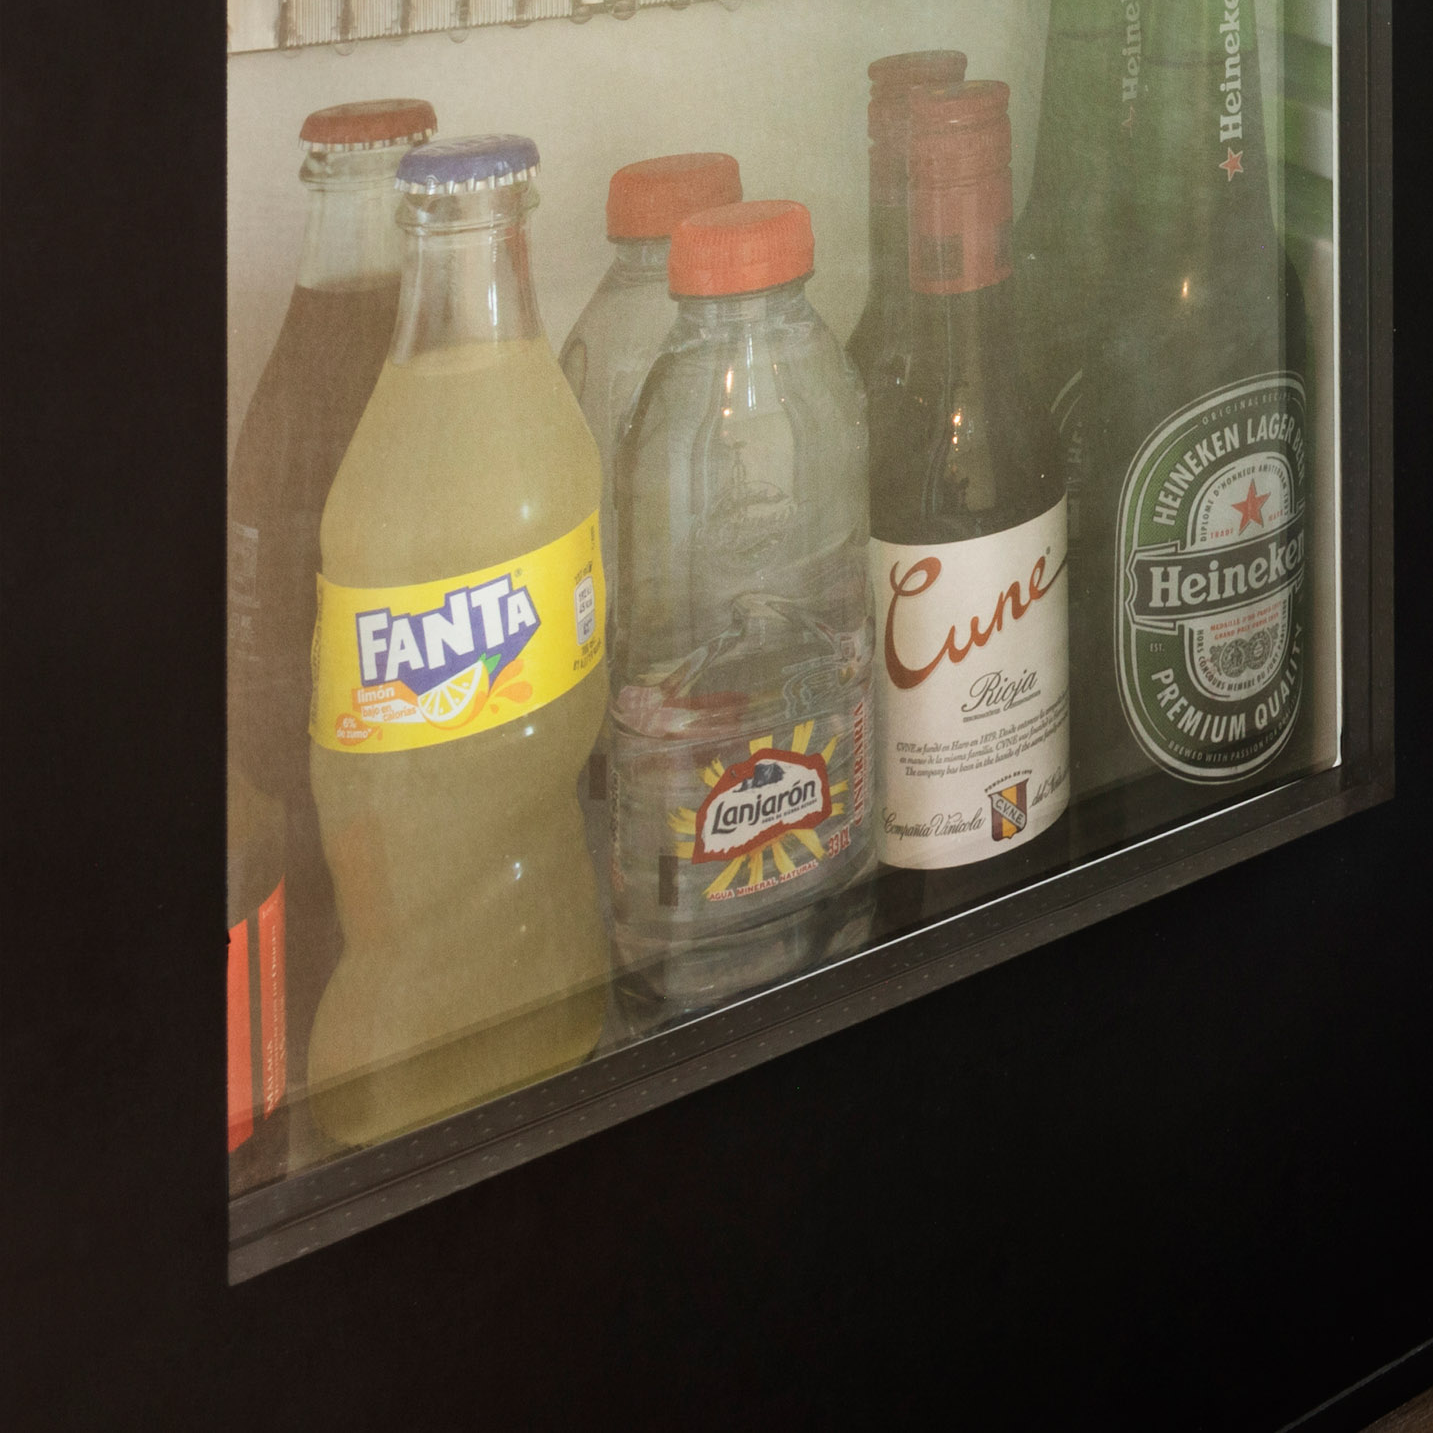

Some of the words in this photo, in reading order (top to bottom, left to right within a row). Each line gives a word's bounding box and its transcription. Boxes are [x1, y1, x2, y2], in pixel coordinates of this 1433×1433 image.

[1152, 422, 1241, 527] HEINEKEN
[1246, 412, 1296, 445] LAGER
[1149, 529, 1305, 608] Heineken
[358, 577, 537, 682] FANTA
[884, 554, 1067, 691] Cune
[357, 684, 395, 705] limón
[961, 669, 1038, 712] Rioja
[1151, 667, 1247, 744] PREMIUM
[1254, 623, 1303, 731] QUALITY
[711, 779, 816, 834] Lanjarón
[827, 833, 840, 859] 33
[708, 889, 734, 902] AGUA
[736, 878, 778, 897] MINERAL
[779, 860, 819, 883] NATURAL
